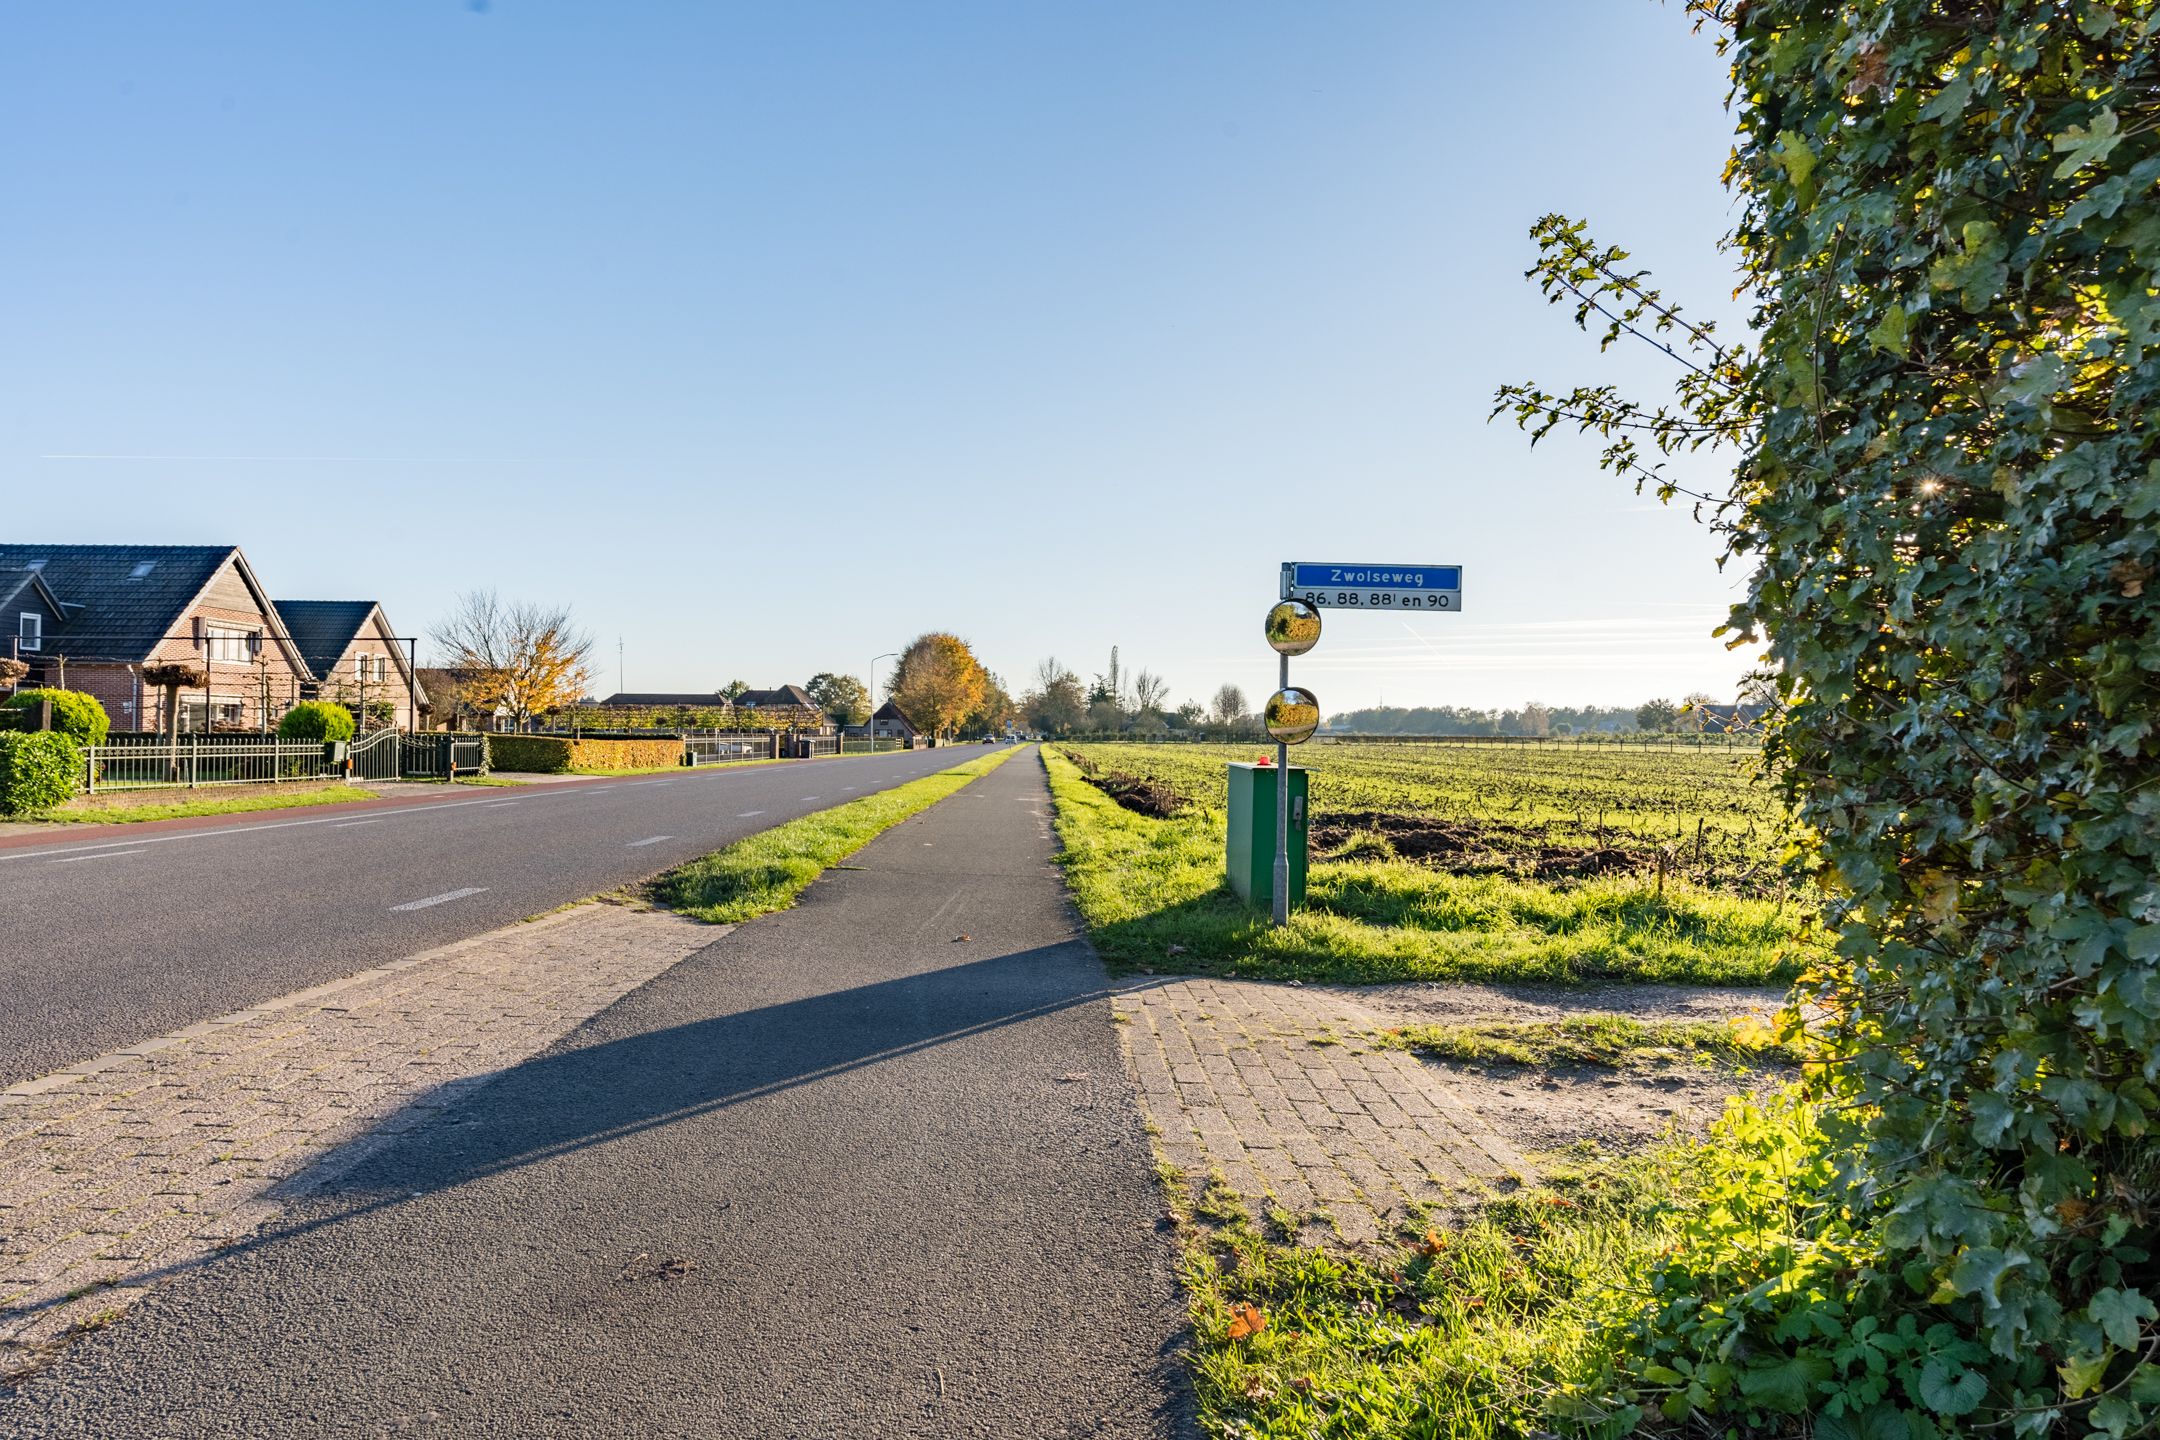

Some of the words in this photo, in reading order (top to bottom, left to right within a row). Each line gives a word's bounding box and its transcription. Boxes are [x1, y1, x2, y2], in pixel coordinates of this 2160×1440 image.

[1331, 569, 1423, 587] Zwolseweg
[1402, 597, 1421, 607] en
[1427, 594, 1449, 607] 90
